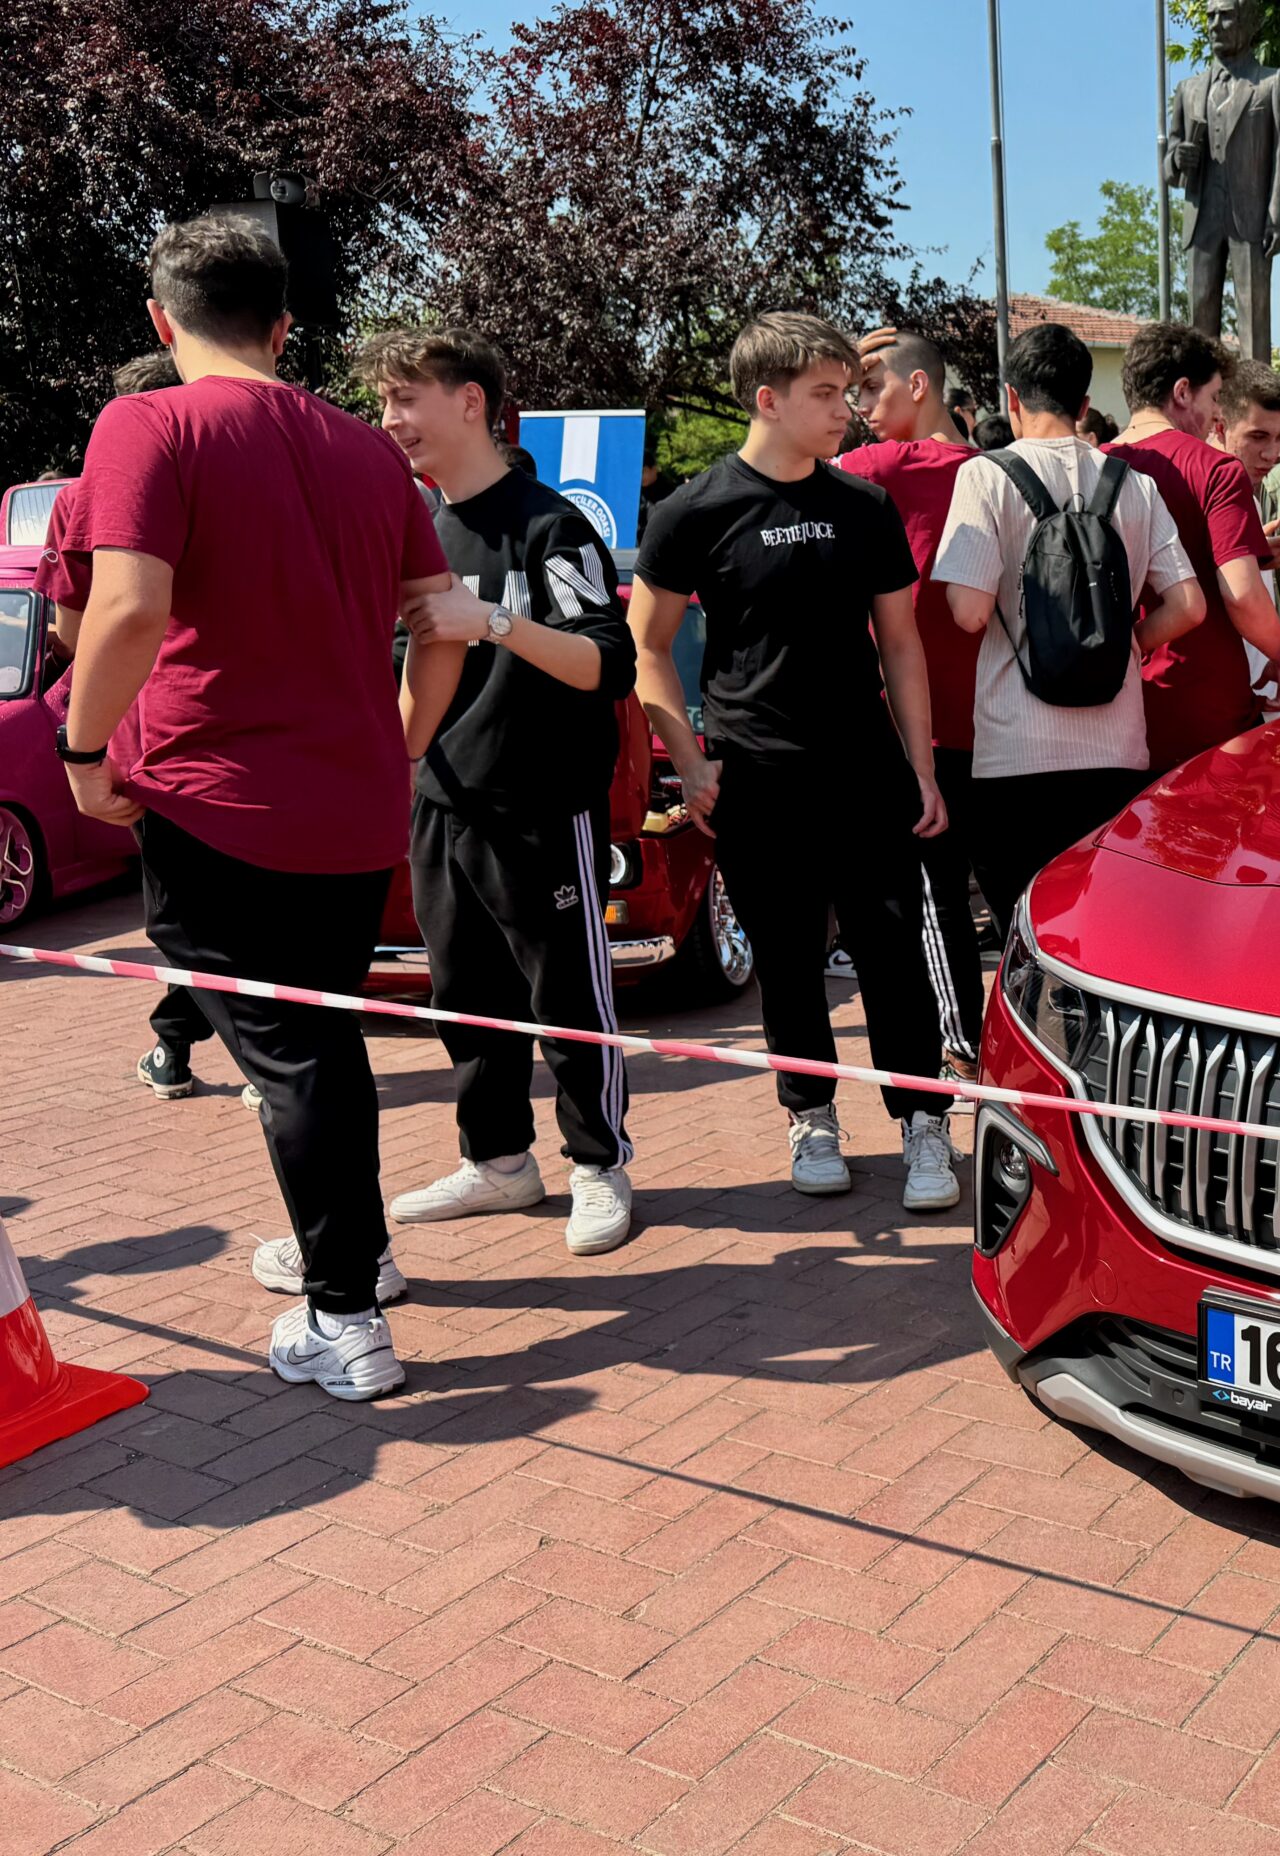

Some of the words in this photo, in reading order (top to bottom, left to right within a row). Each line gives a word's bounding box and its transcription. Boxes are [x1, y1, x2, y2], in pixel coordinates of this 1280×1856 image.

[760, 521, 836, 547] BEETLEJUICE
[1209, 1349, 1232, 1372] TR
[1229, 1391, 1273, 1412] bay.air
